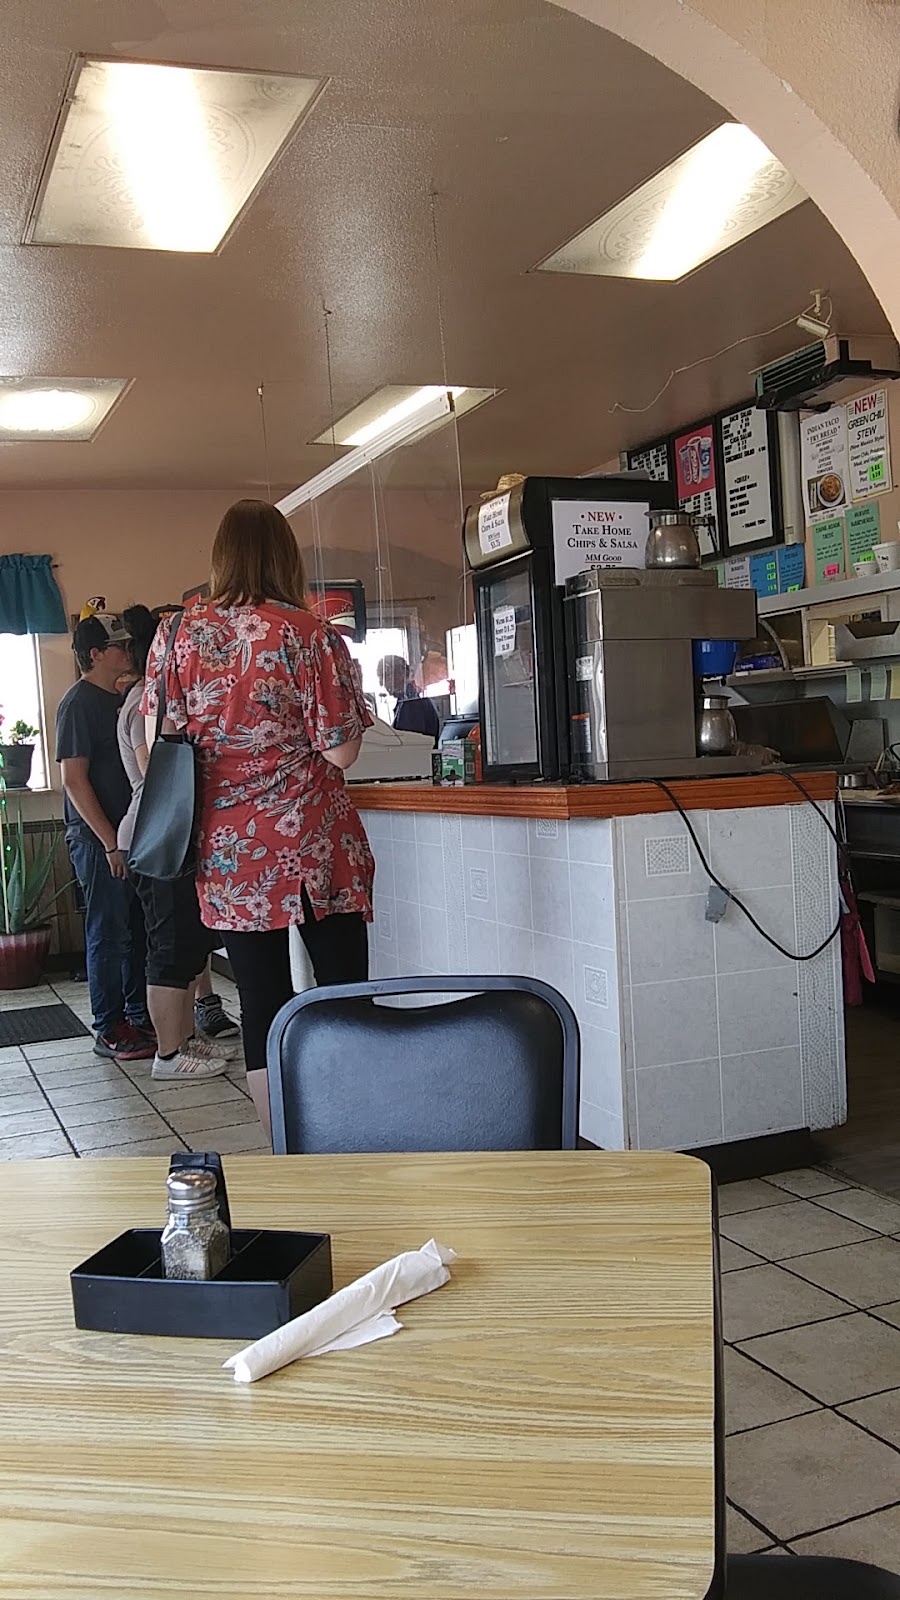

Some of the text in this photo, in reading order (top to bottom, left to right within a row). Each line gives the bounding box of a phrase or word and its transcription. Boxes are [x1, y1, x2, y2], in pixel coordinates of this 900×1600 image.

[854, 394, 878, 415] NEW
[806, 416, 840, 435] INDIAN TACO
[848, 414, 868, 430] GREEN
[820, 427, 838, 439] BREAD
[856, 425, 878, 440] STEW
[588, 512, 616, 522] NEW
[572, 524, 632, 536] TAKE HOME
[567, 538, 638, 549] CHIPS & SALSA
